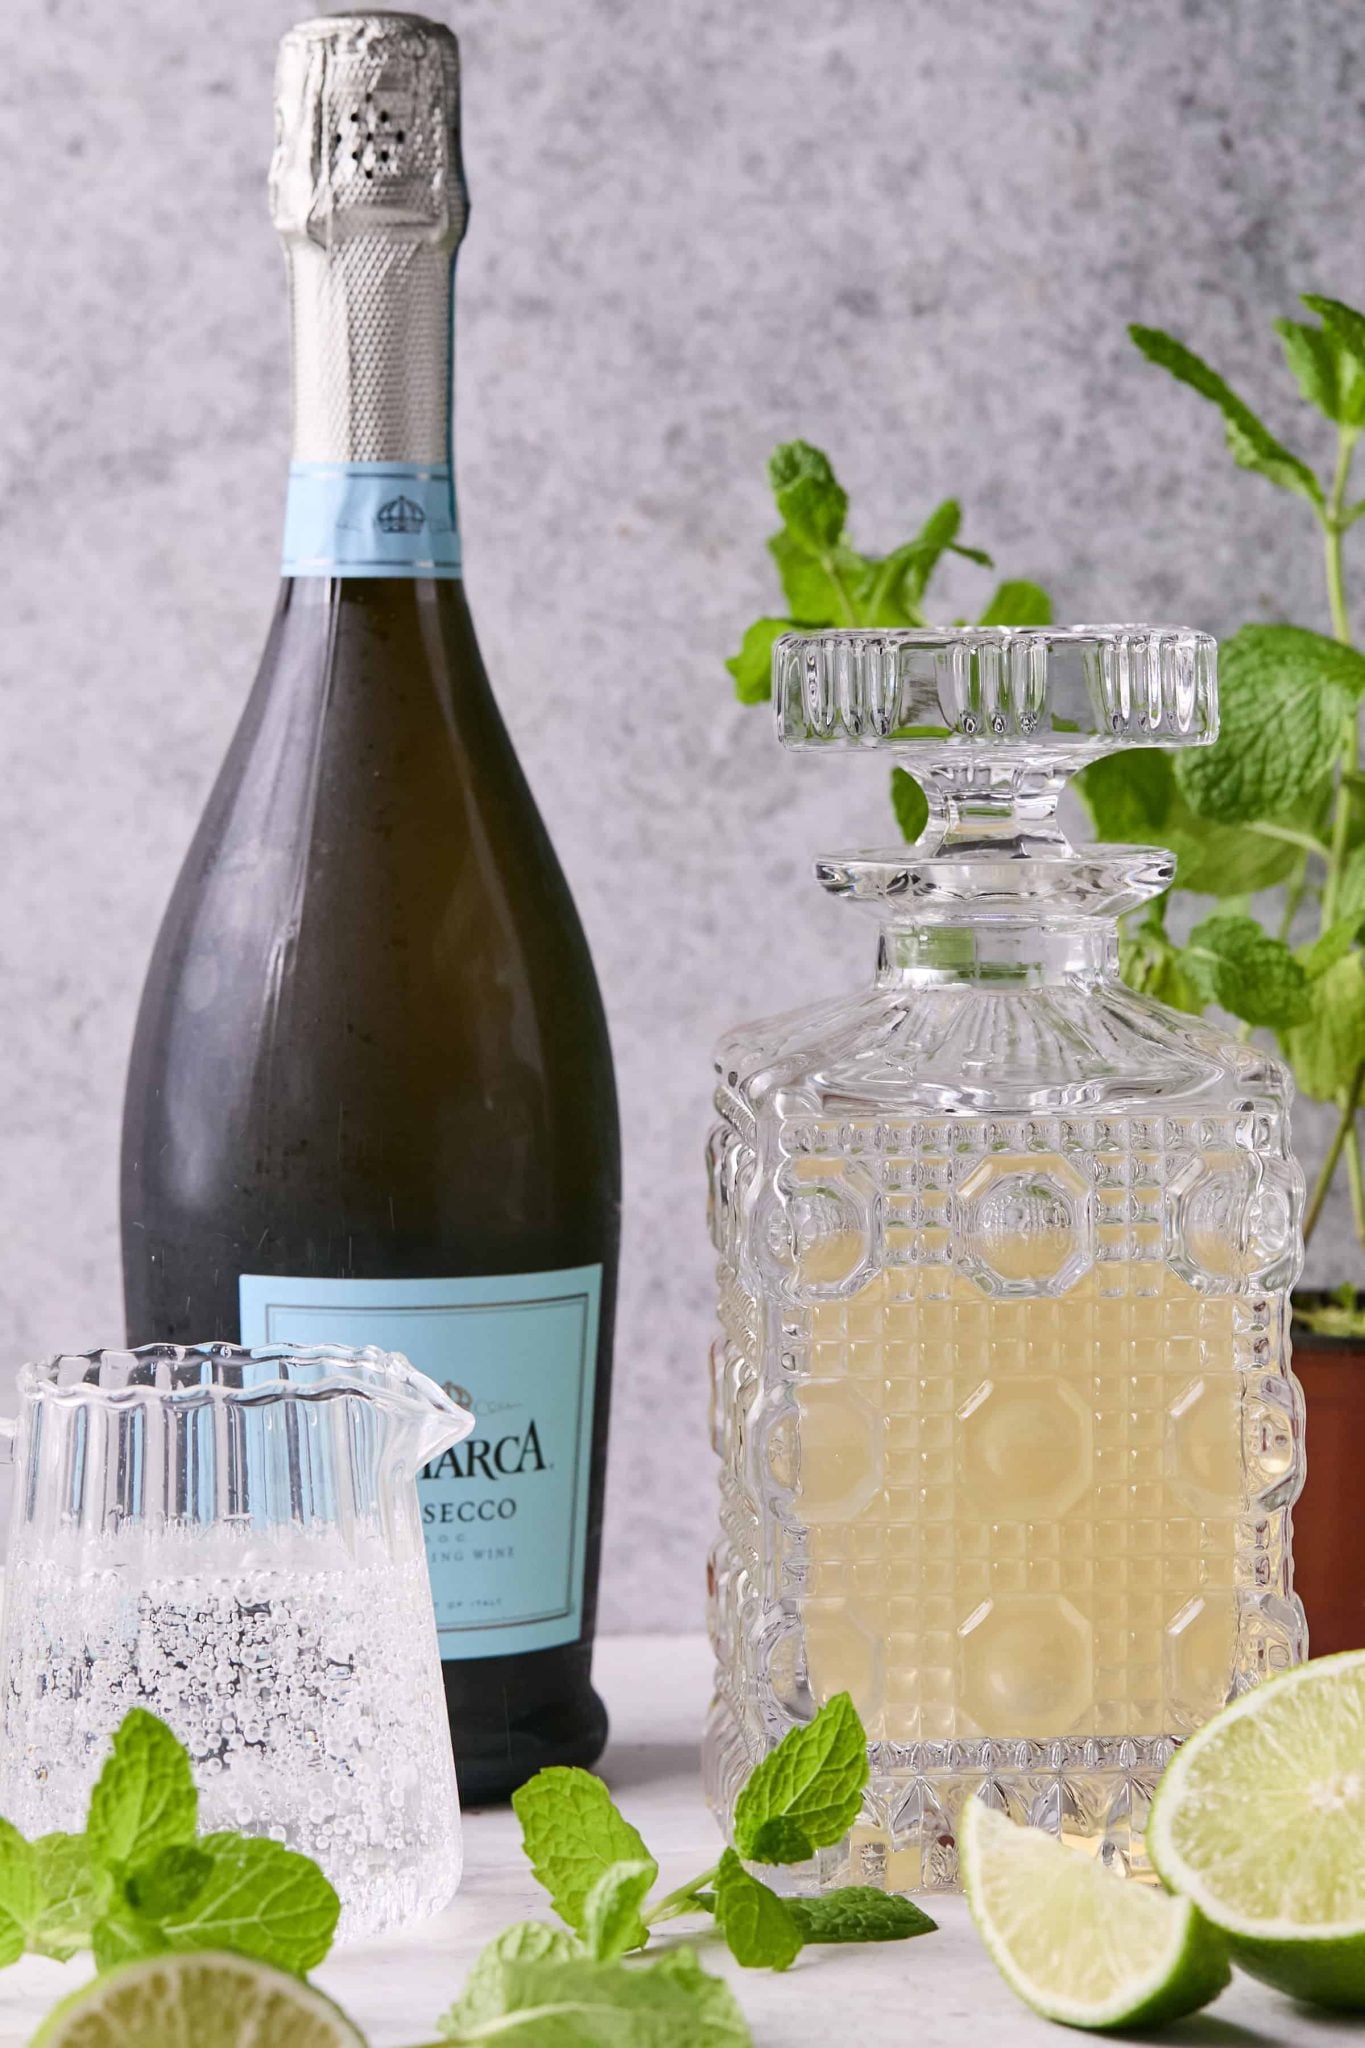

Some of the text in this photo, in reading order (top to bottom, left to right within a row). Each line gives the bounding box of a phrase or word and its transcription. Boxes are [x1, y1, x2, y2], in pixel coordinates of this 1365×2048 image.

[421, 1419, 546, 1481] ARCA
[423, 1498, 517, 1524] SECCO
[431, 1551, 465, 1563] ING
